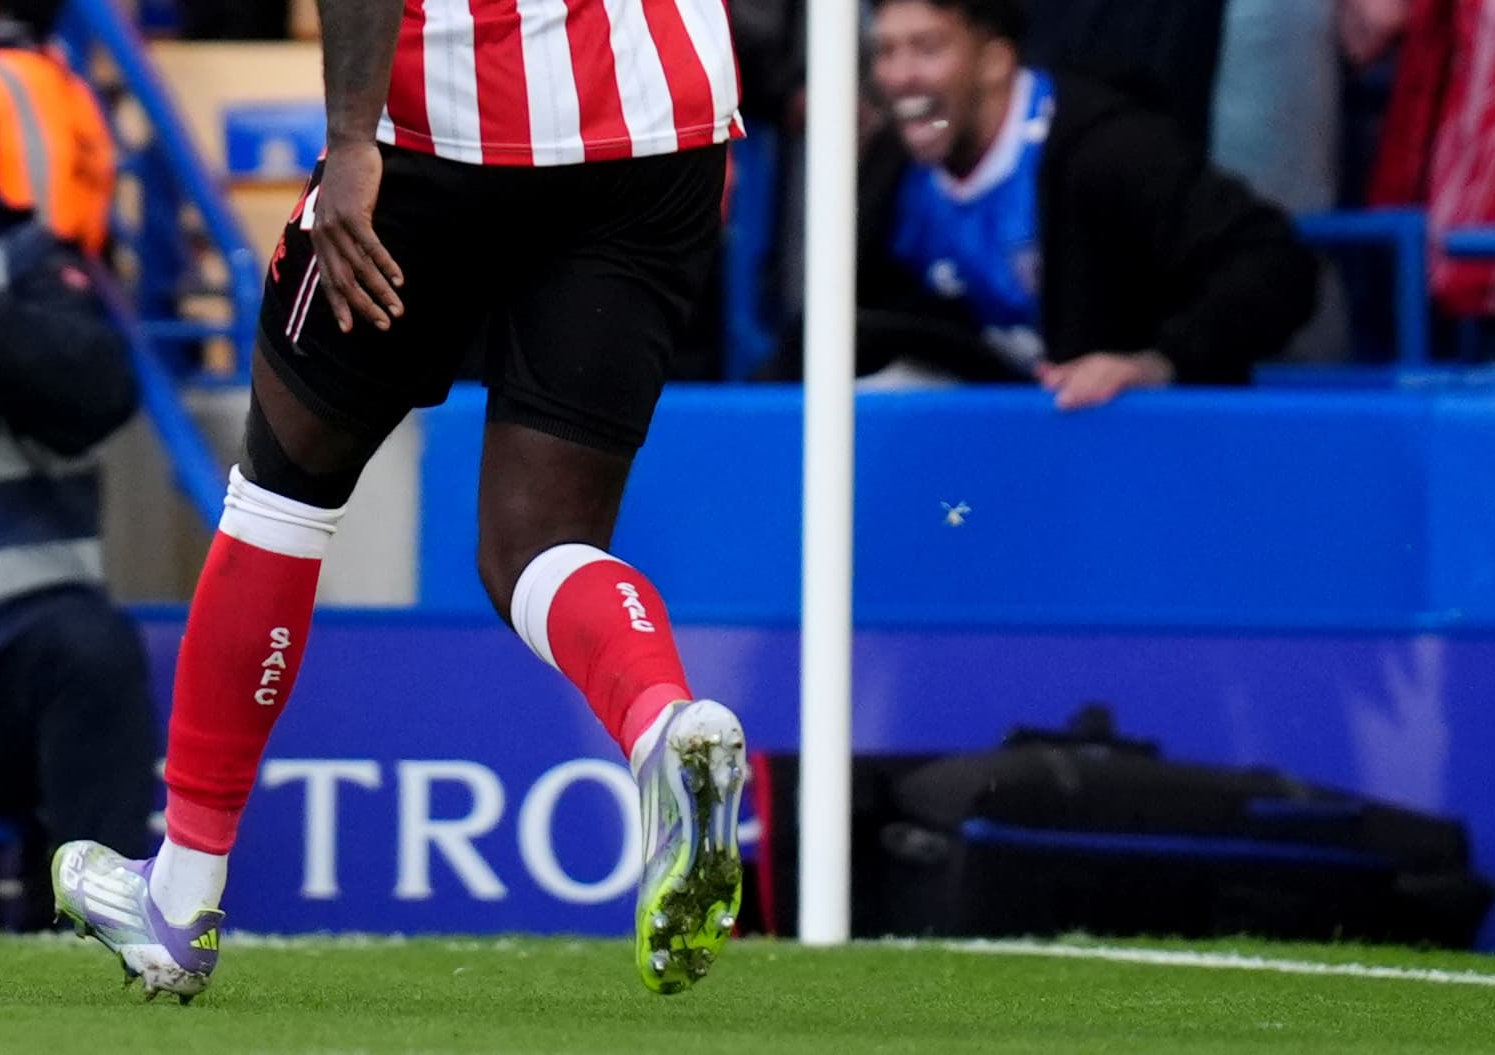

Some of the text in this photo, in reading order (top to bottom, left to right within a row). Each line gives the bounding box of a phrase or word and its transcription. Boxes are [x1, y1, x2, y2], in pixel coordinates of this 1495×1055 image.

[615, 581, 656, 633] SAFC
[253, 626, 292, 706] SAFC
[260, 758, 644, 905] TRO
